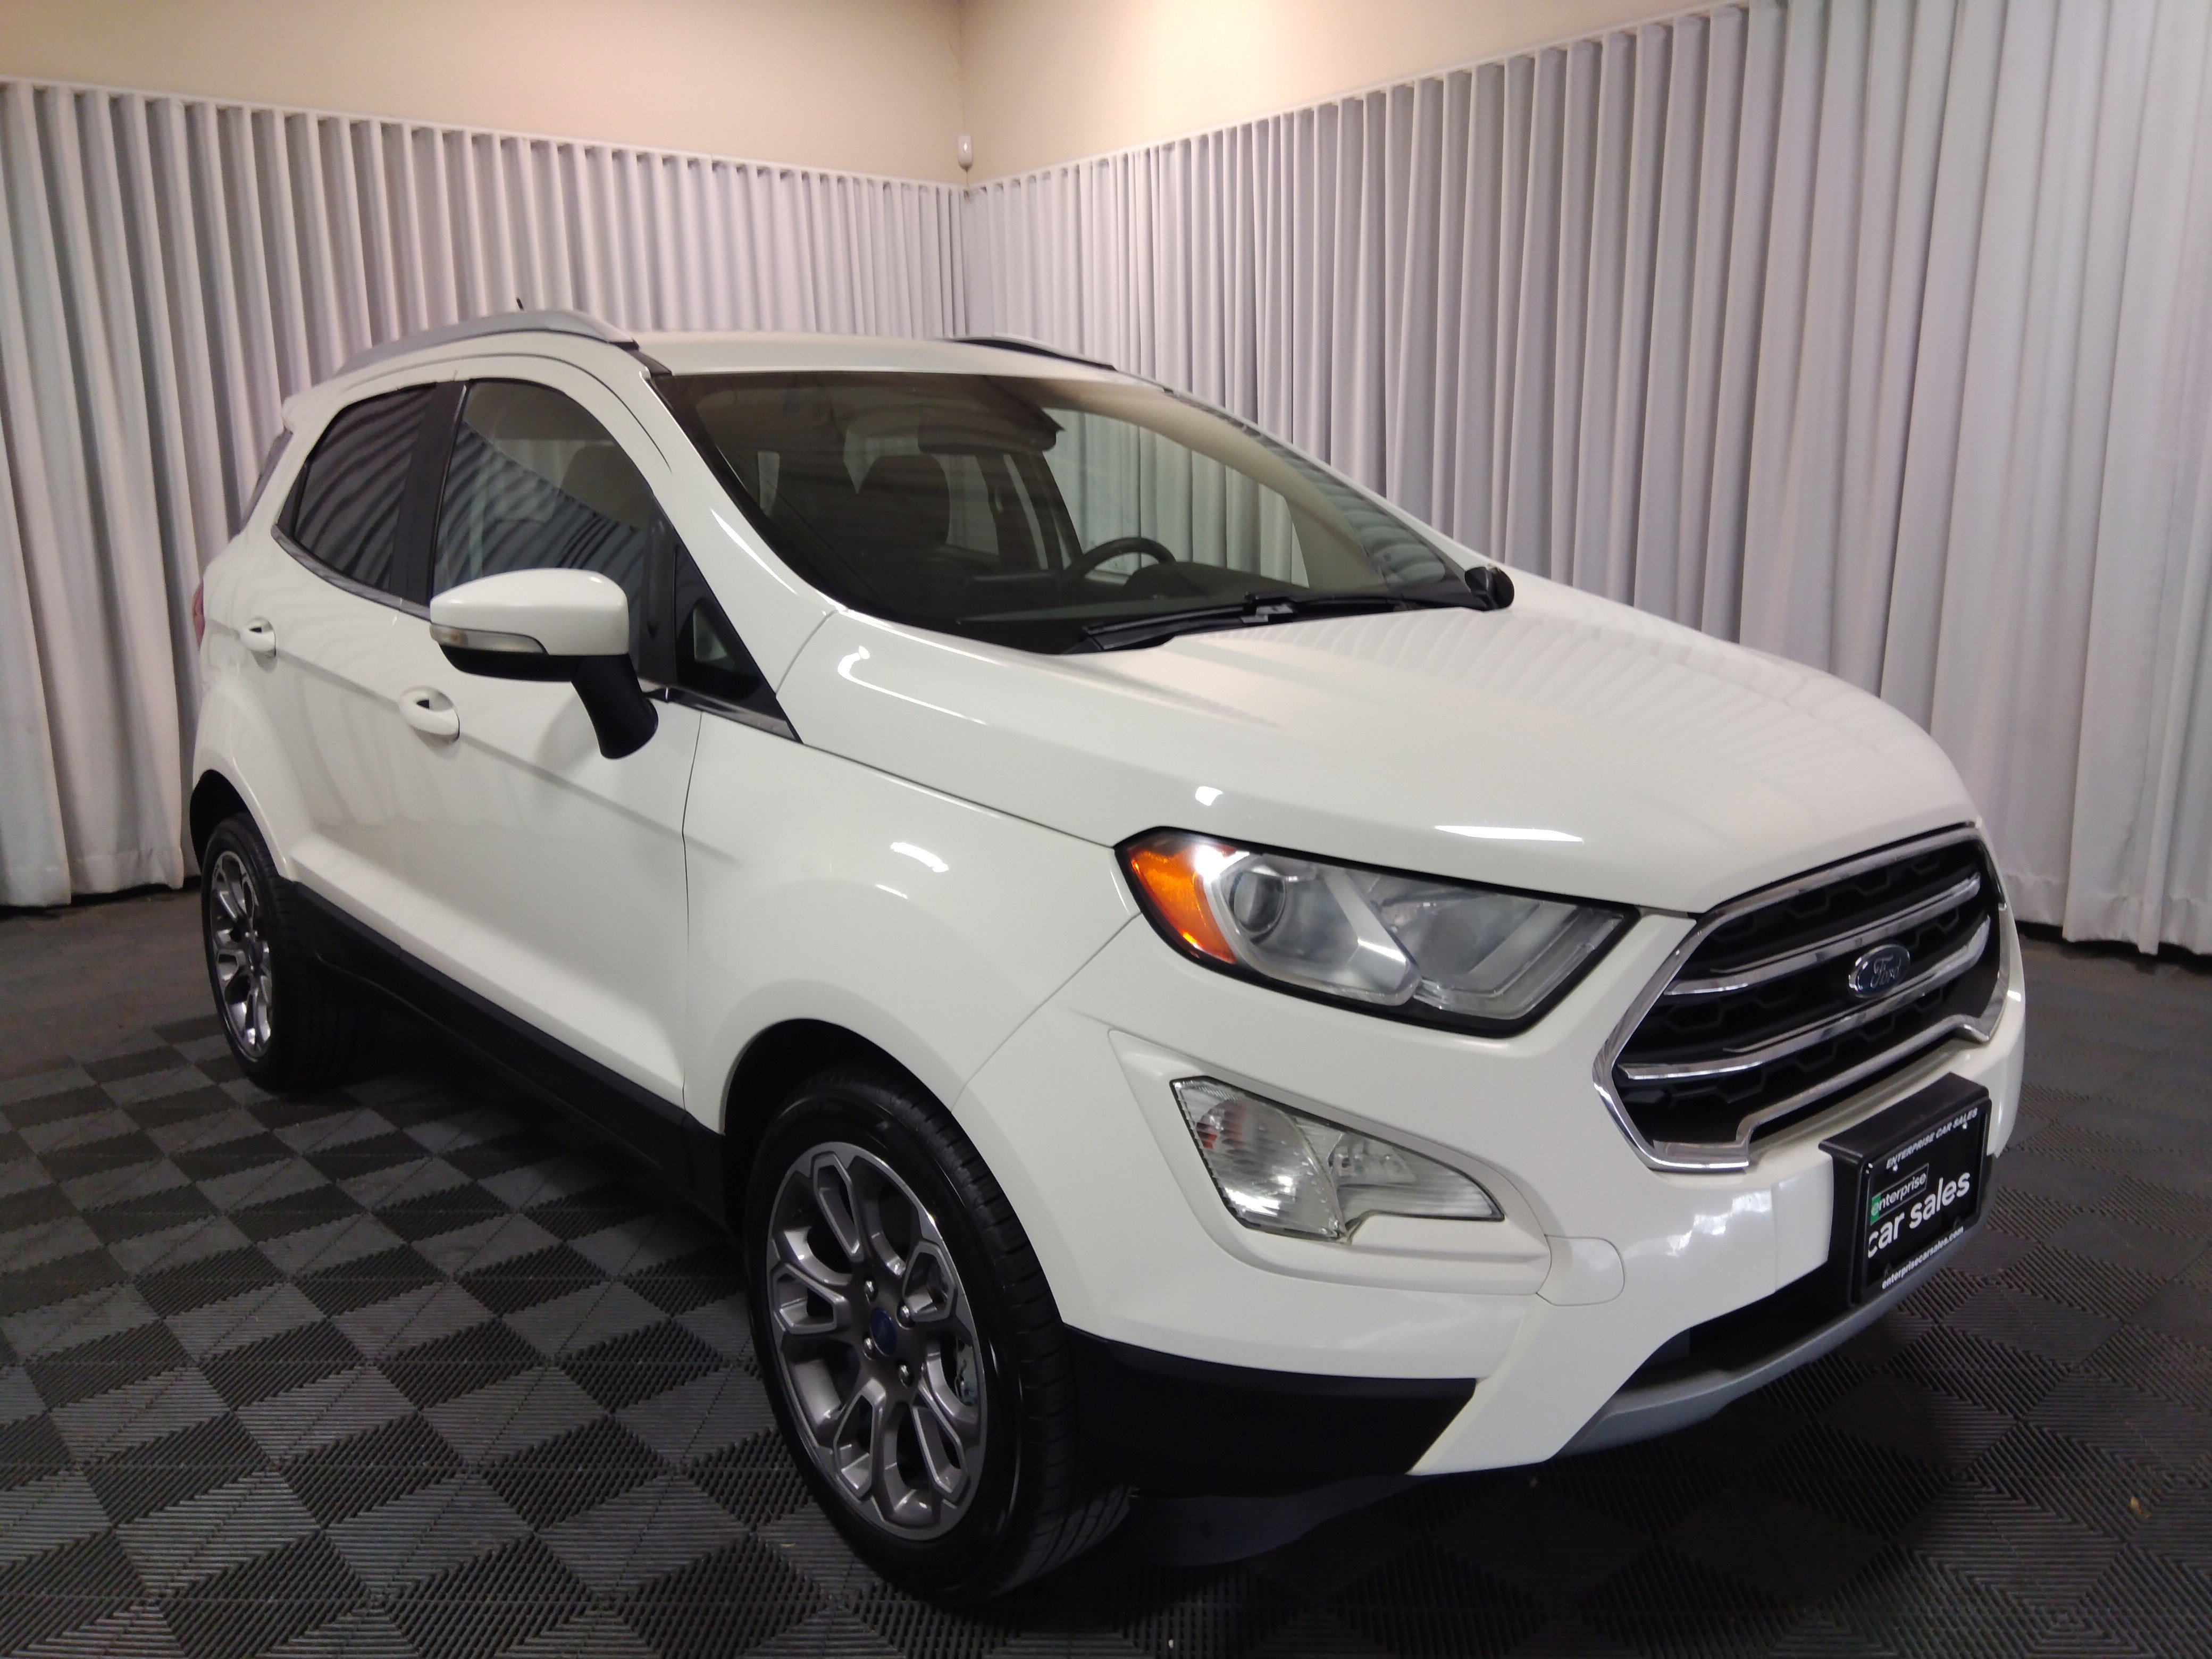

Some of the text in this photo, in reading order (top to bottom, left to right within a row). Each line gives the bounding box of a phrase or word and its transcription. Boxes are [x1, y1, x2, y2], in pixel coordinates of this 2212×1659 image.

[1868, 1172, 1971, 1259] car sales
[1870, 1172, 1926, 1216] enterprise
